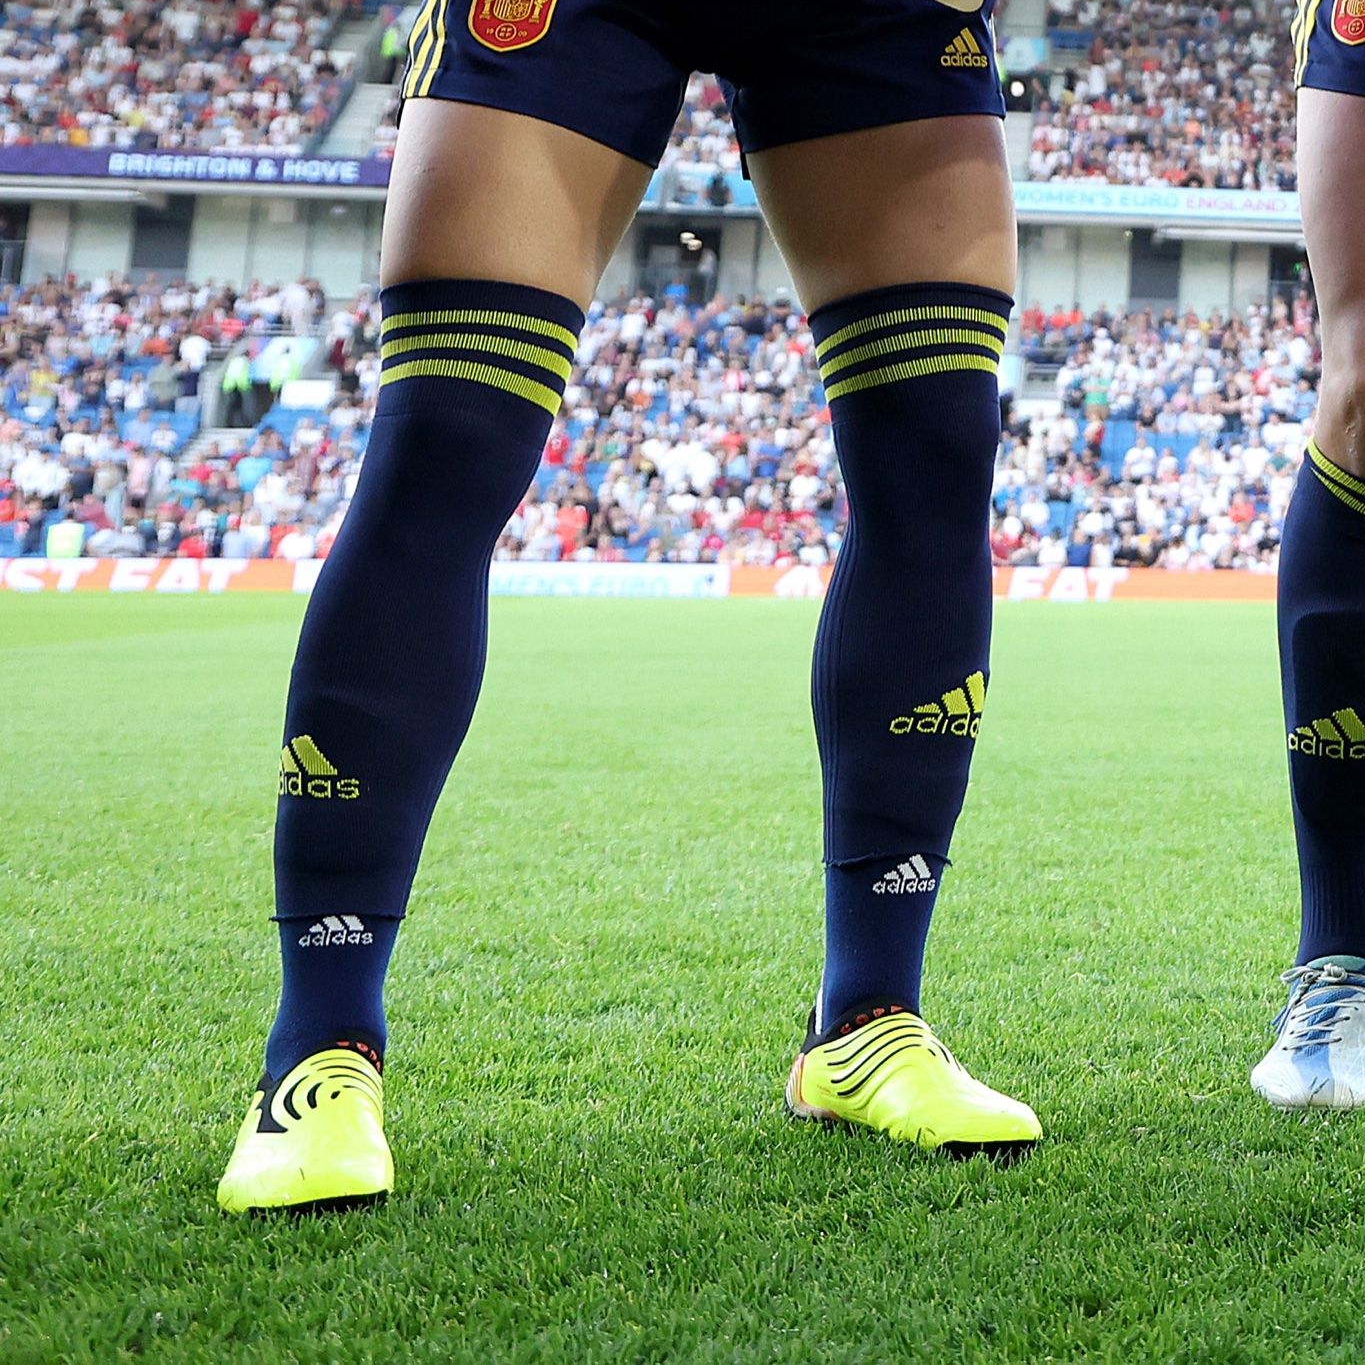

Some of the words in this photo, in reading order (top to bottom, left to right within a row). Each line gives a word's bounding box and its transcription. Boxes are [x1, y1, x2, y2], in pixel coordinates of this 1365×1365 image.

[940, 52, 988, 69] adidas
[108, 152, 252, 179] BRIGHTON
[255, 157, 279, 181] &
[283, 158, 361, 183] HOVE
[1119, 191, 1179, 208] EURO
[1185, 194, 1287, 212] ENGLAND
[0, 557, 99, 594] ST
[108, 557, 252, 594] EAT
[1007, 566, 1130, 603] EAT
[889, 712, 980, 738] adida
[872, 875, 936, 895] adidas
[299, 928, 374, 947] adidas
